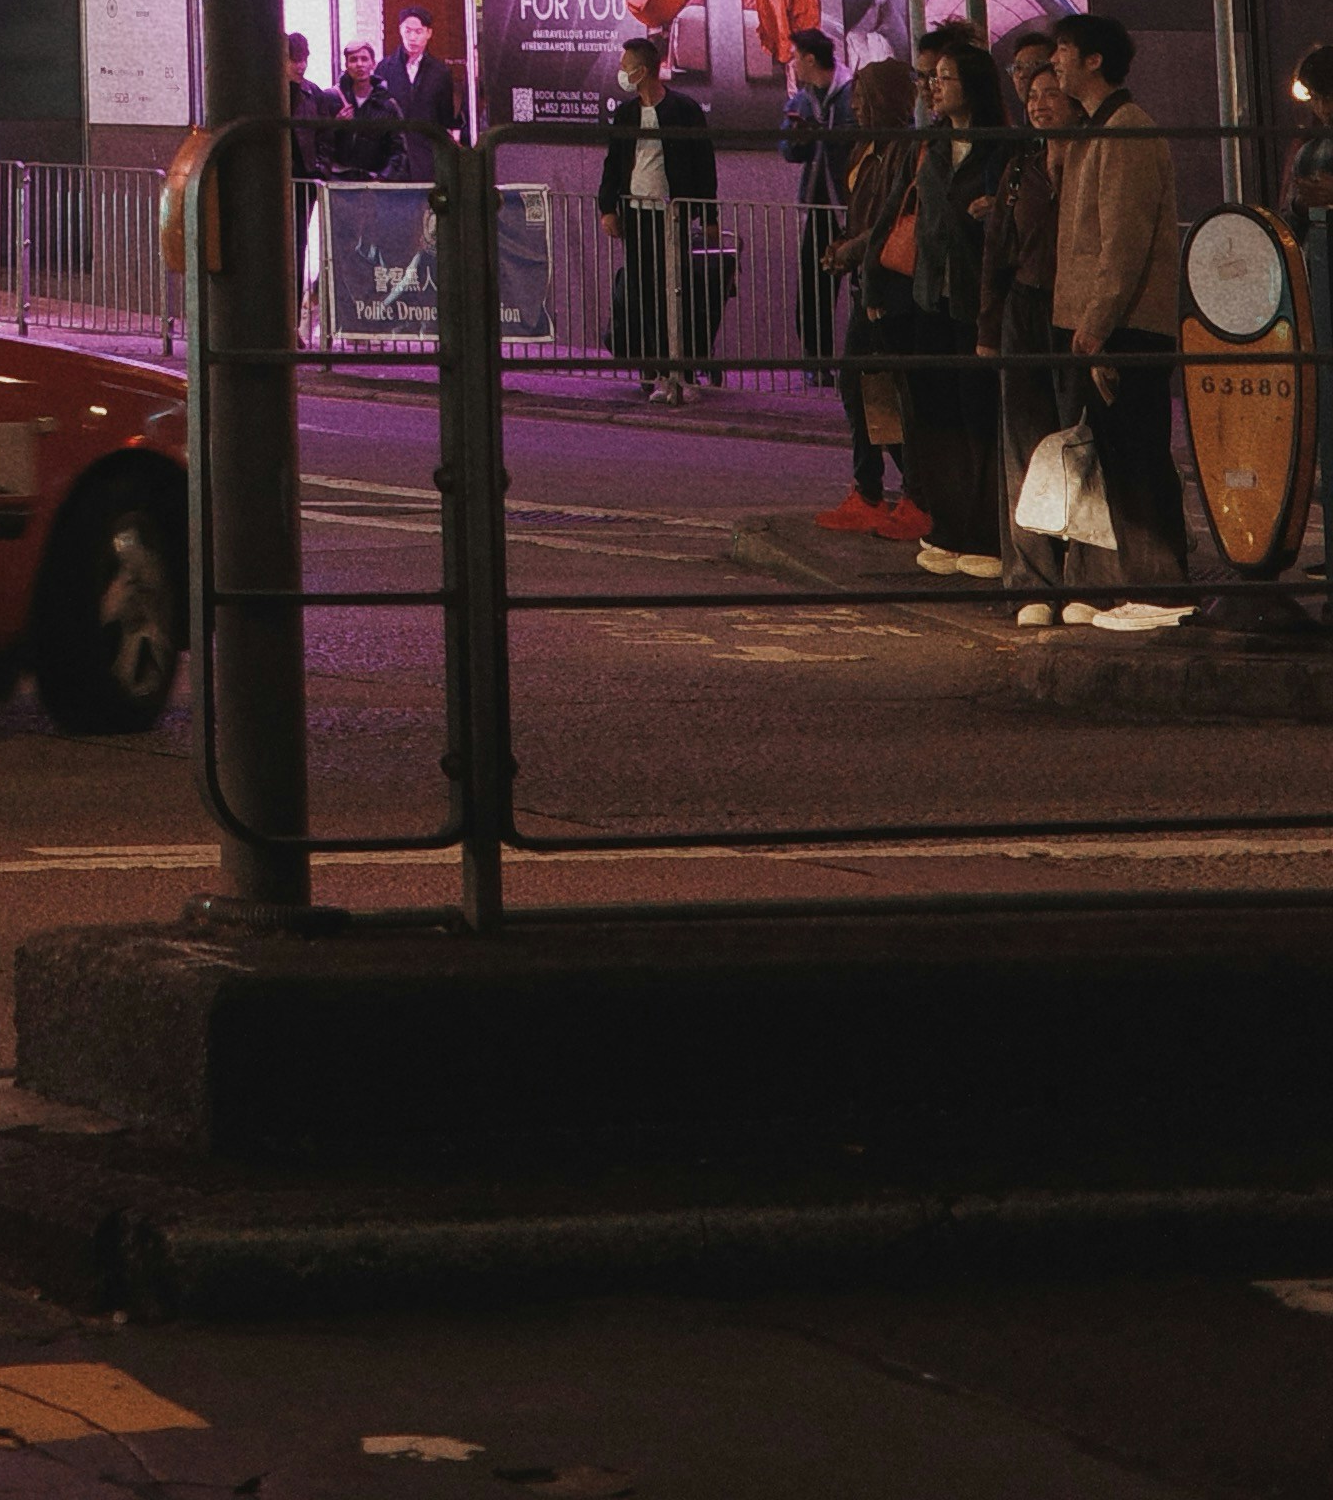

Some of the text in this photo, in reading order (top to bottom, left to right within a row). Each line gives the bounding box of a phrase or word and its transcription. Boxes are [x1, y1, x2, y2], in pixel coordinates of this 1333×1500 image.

[535, 91, 600, 102] BOOK ONLINE NOW
[561, 103, 580, 115] 2315
[355, 300, 438, 322] Police Drone
[1200, 375, 1292, 399] 63880
